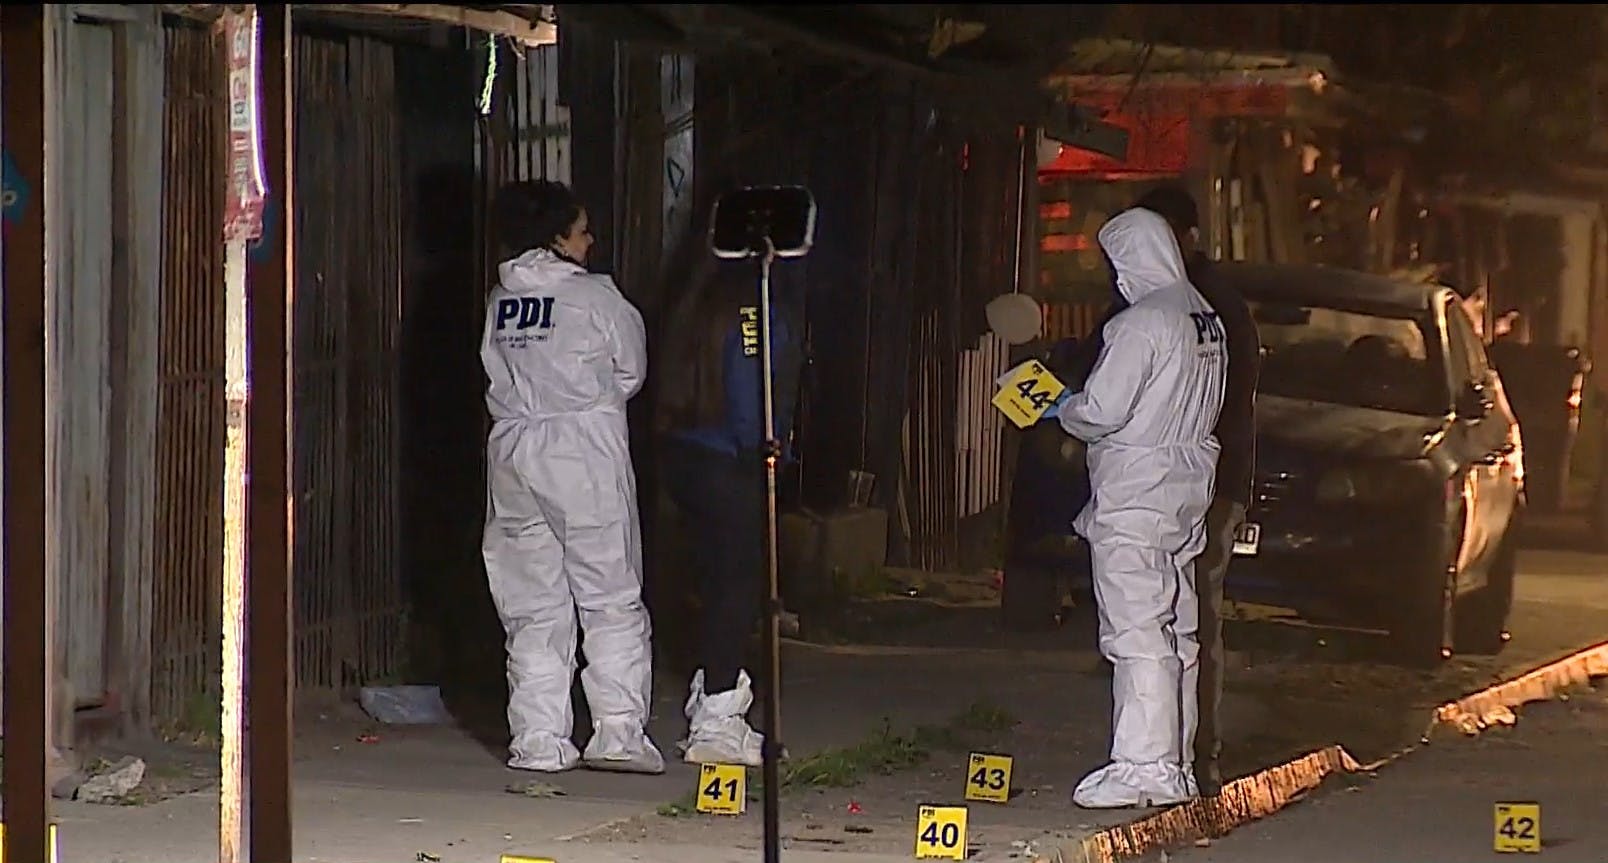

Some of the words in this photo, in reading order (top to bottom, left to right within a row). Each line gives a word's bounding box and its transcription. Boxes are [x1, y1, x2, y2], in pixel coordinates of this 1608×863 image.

[1016, 379, 1051, 410] 44
[703, 777, 738, 802] 41
[971, 767, 1005, 790] 43
[920, 822, 959, 848] 40
[1499, 816, 1535, 839] 42
